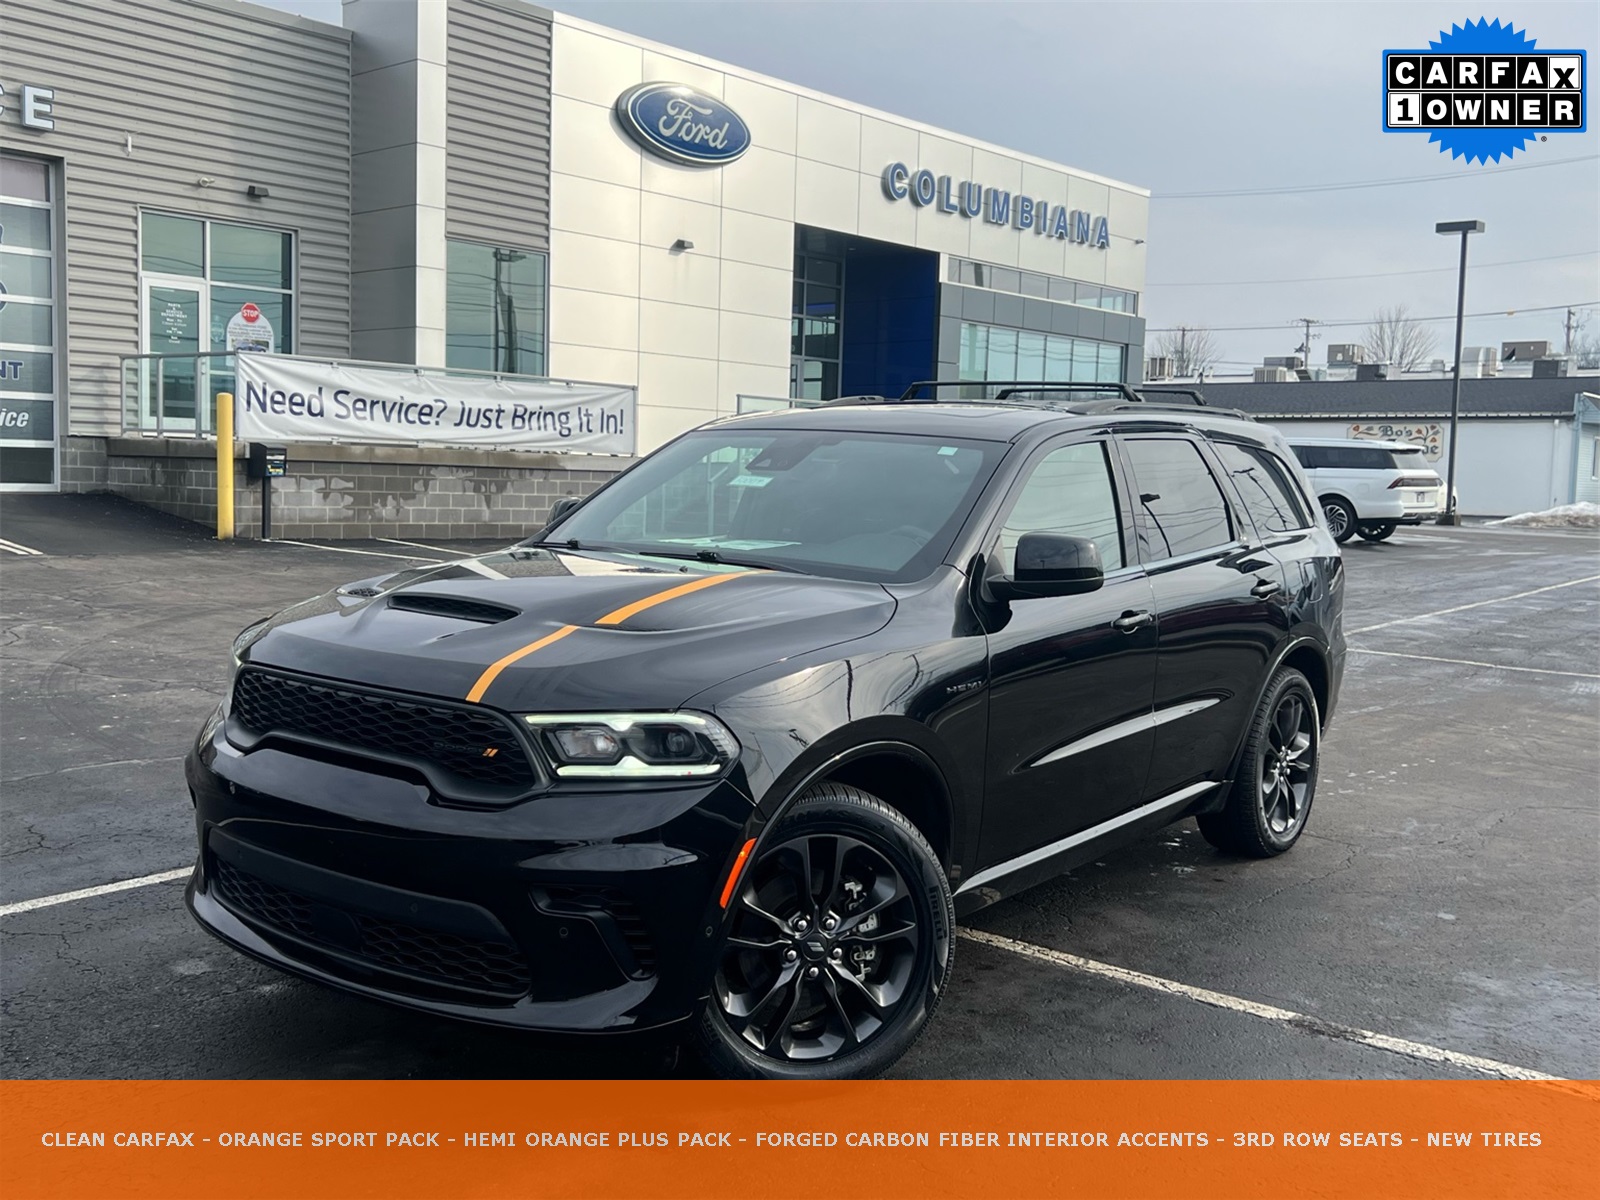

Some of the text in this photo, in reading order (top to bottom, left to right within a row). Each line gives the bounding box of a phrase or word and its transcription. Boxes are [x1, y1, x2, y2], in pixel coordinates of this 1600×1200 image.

[0, 84, 55, 131] E
[658, 98, 730, 150] Ford
[882, 161, 1111, 249] COLUMBIANA
[243, 309, 259, 318] STOP
[246, 380, 625, 438] Need Service? Just Bring It In!
[1378, 425, 1413, 438] Bo's
[929, 885, 948, 941] PIRELLI
